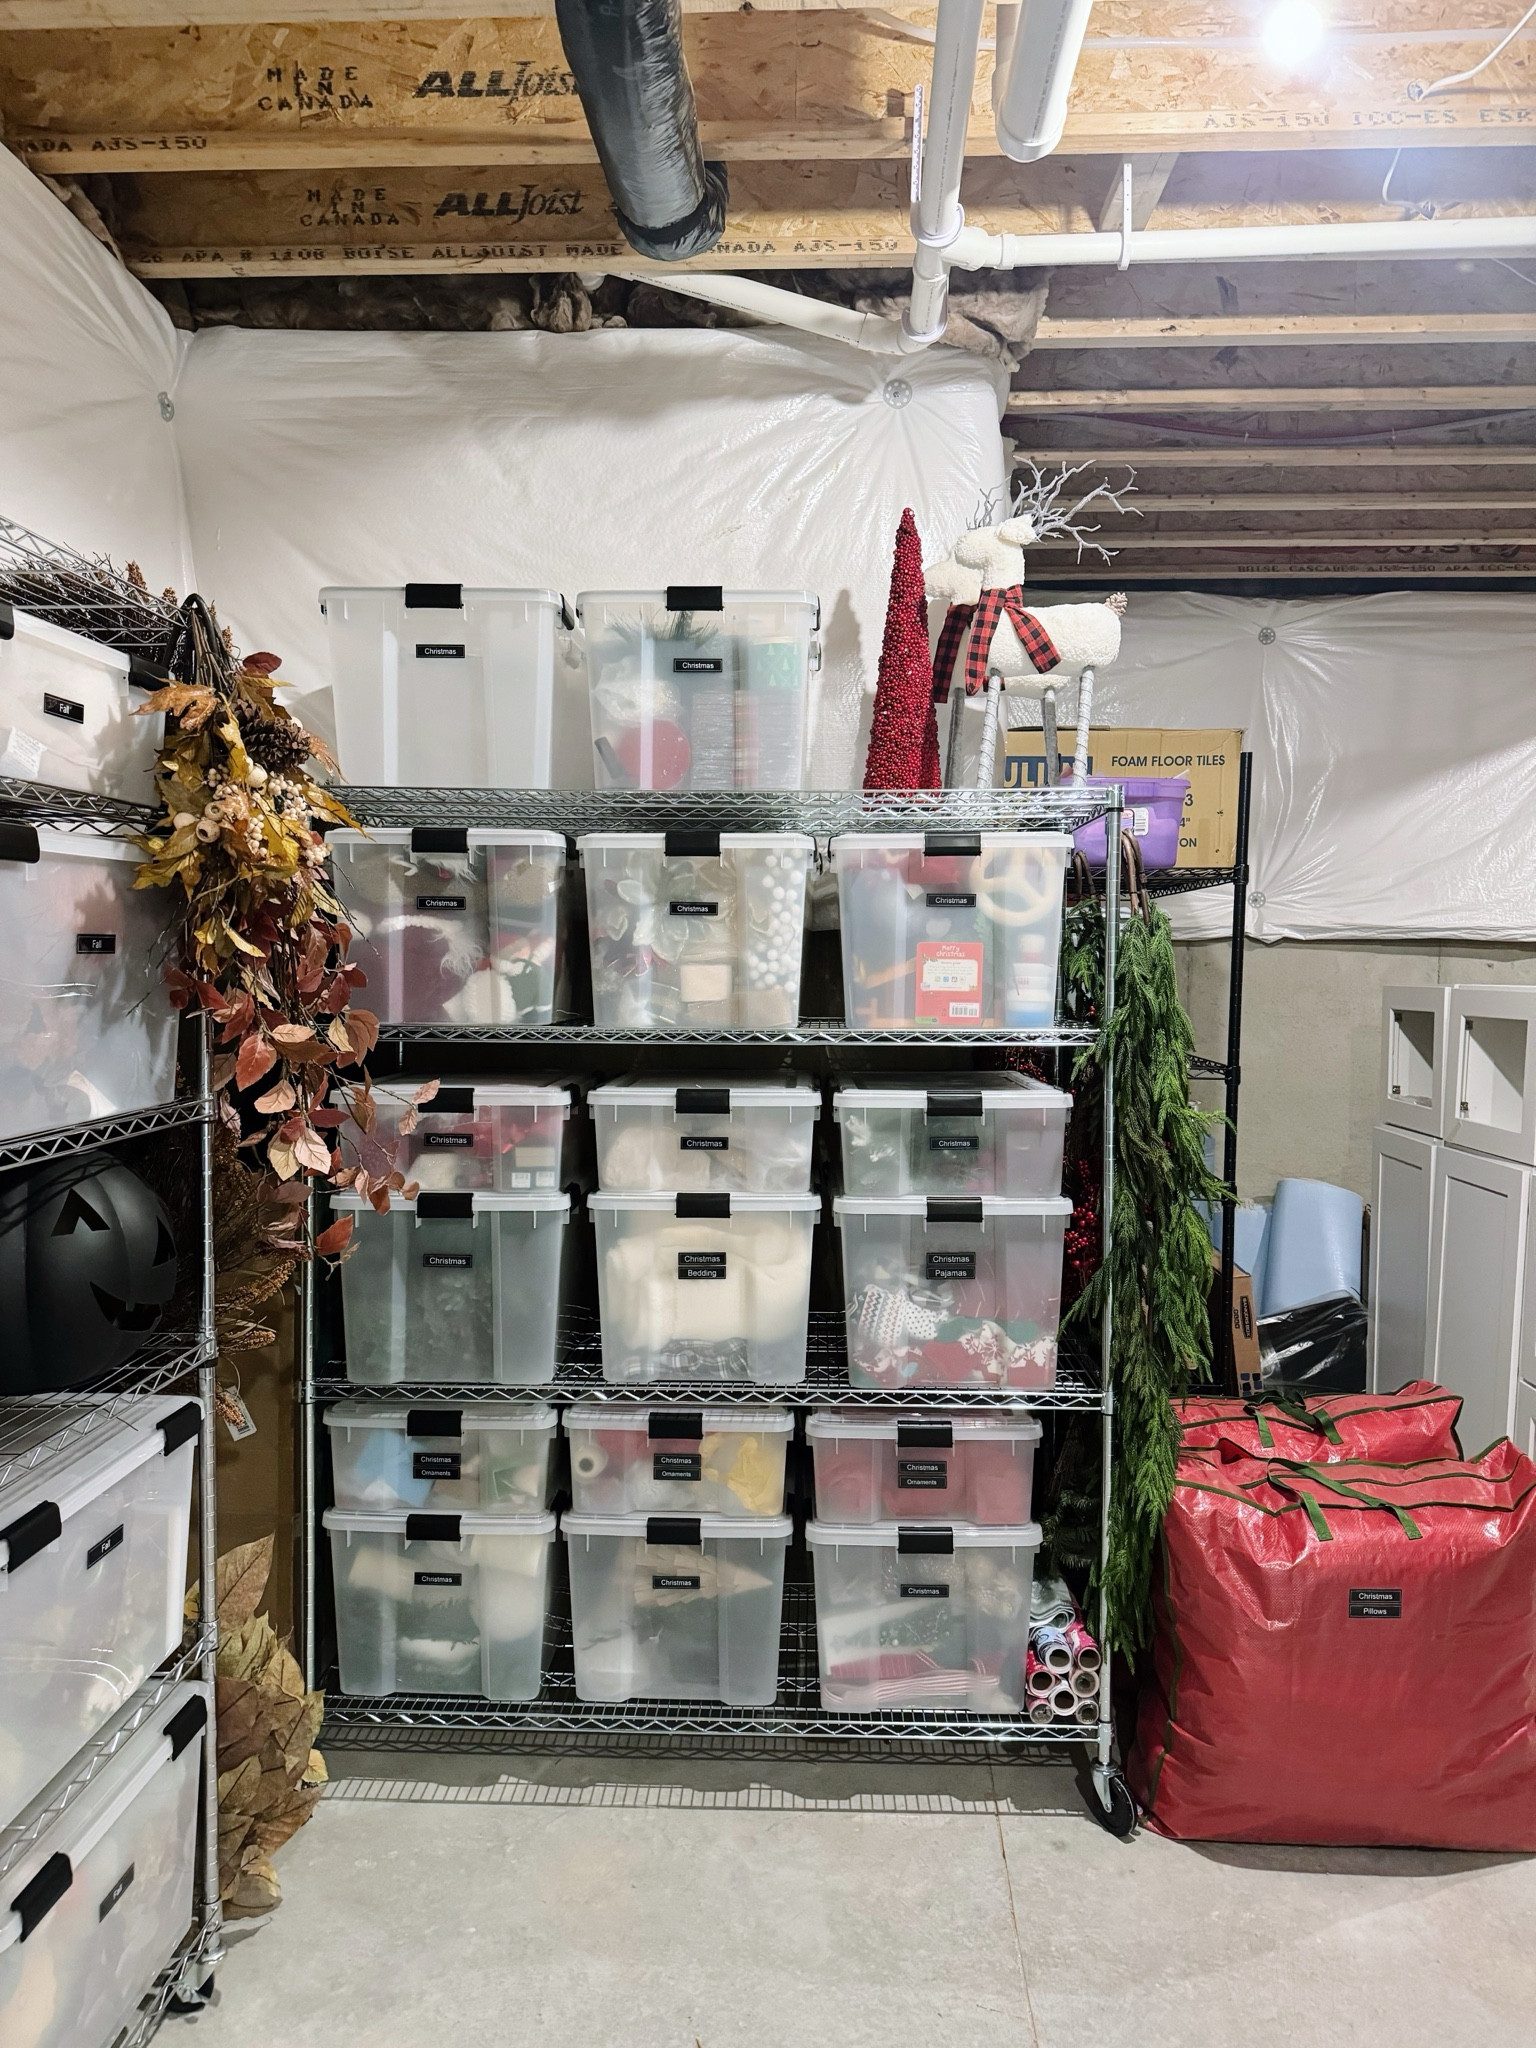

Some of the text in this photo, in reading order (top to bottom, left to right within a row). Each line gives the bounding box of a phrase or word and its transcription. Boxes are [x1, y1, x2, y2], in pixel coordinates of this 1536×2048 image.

[266, 66, 359, 83] MADE
[294, 81, 334, 96] IN
[257, 94, 374, 112] CANADA
[1351, 109, 1458, 126] ICC-ES
[91, 135, 208, 152] AJS-150
[307, 187, 387, 203] MADE
[329, 201, 366, 214] IN
[433, 183, 589, 226] ALLJoist
[299, 212, 401, 228] CANADA
[181, 249, 225, 263] APA
[431, 240, 547, 259] ALLJOIST
[565, 235, 625, 257] MADE
[793, 239, 899, 255] AJS-150
[424, 646, 457, 656] Christmas
[682, 661, 715, 670] Christmas
[59, 702, 71, 715] Fall
[1111, 754, 1226, 767] FOAM FLOOR TILES
[425, 899, 458, 908] Christmas
[935, 896, 968, 905] Christmas
[677, 904, 709, 913] Christmas
[91, 938, 102, 949] Fall
[430, 1136, 468, 1145] Christmas
[686, 1139, 723, 1148] Christmas
[938, 1139, 971, 1148] Christmas
[429, 1256, 467, 1265] Christmas
[684, 1255, 721, 1264] Christmas
[932, 1255, 970, 1263] Christmas
[687, 1269, 718, 1279] Bedding
[935, 1269, 968, 1279] Pajamas
[420, 1455, 452, 1463] Christmas
[660, 1456, 692, 1464] Christmas
[906, 1463, 939, 1471] Christmas
[421, 1469, 451, 1477] Ornaments
[661, 1470, 692, 1478] Ornaments
[906, 1476, 937, 1485] Ornaments
[907, 1587, 940, 1595] Christmas
[1358, 1591, 1393, 1600] Christmas
[1363, 1607, 1388, 1616] Pillows
